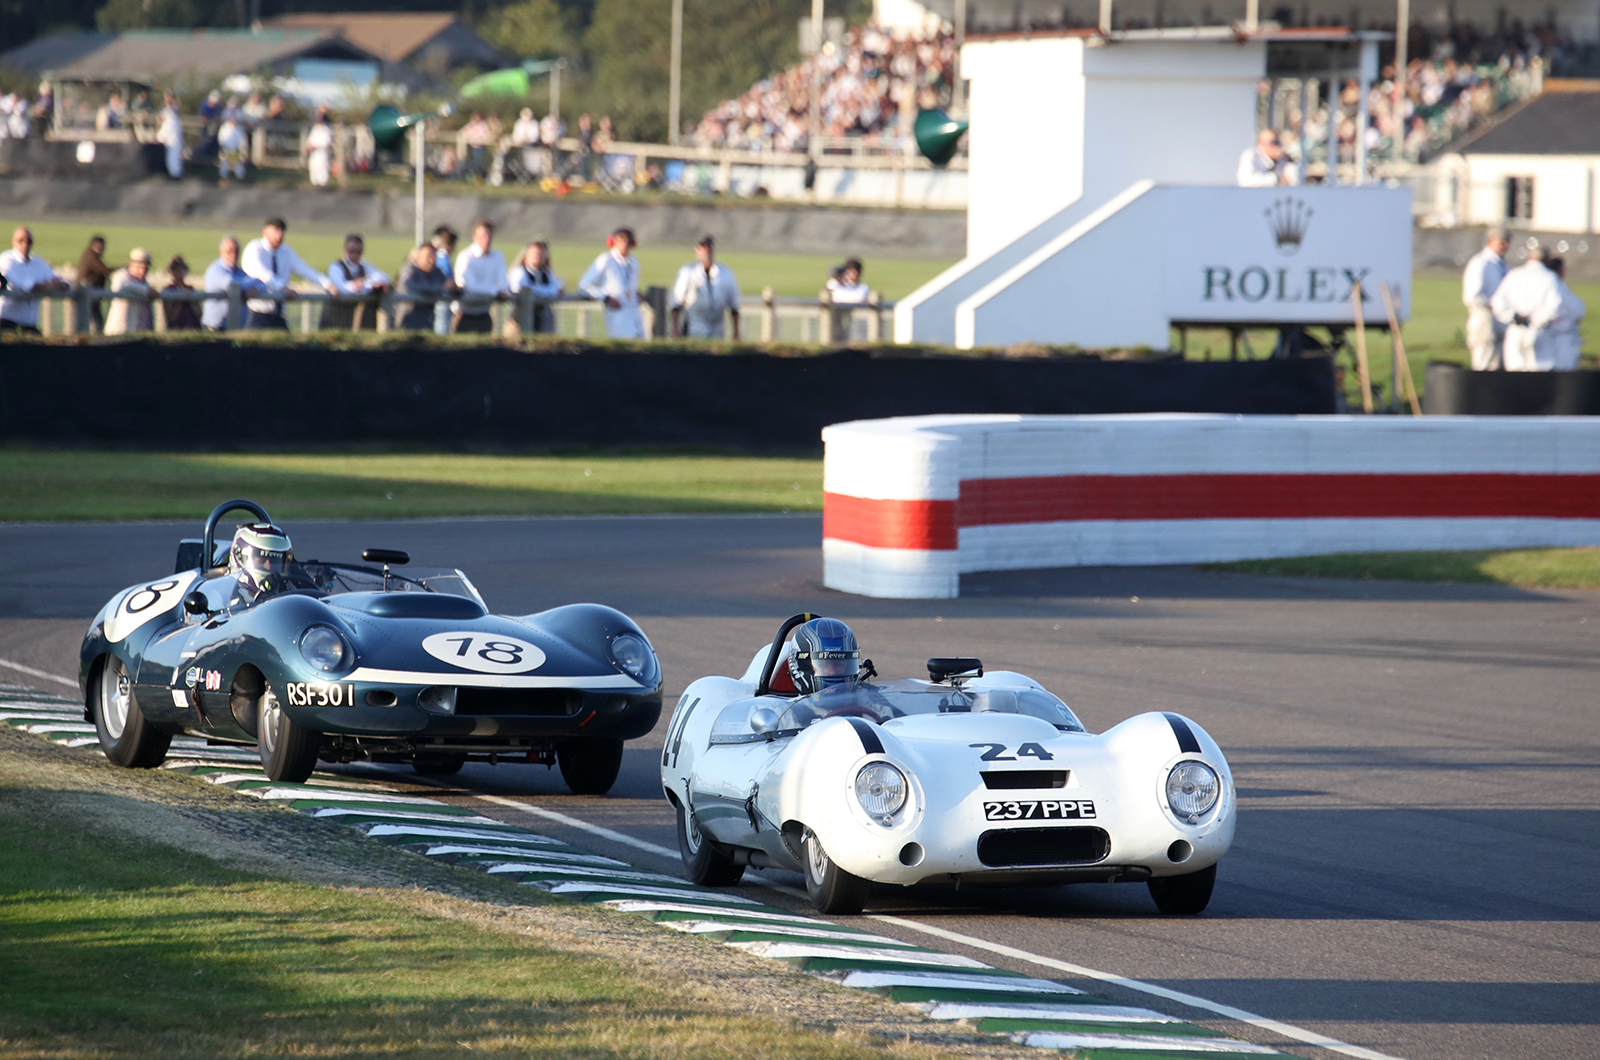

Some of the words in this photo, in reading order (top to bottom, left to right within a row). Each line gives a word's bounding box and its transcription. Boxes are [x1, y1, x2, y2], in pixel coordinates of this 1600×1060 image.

[1201, 264, 1373, 302] ROLEX
[114, 580, 179, 619] 18
[446, 637, 524, 665] 18
[819, 651, 846, 659] #Fever
[286, 682, 355, 707] RSF301
[662, 693, 701, 769] 24
[968, 742, 1055, 762] 24
